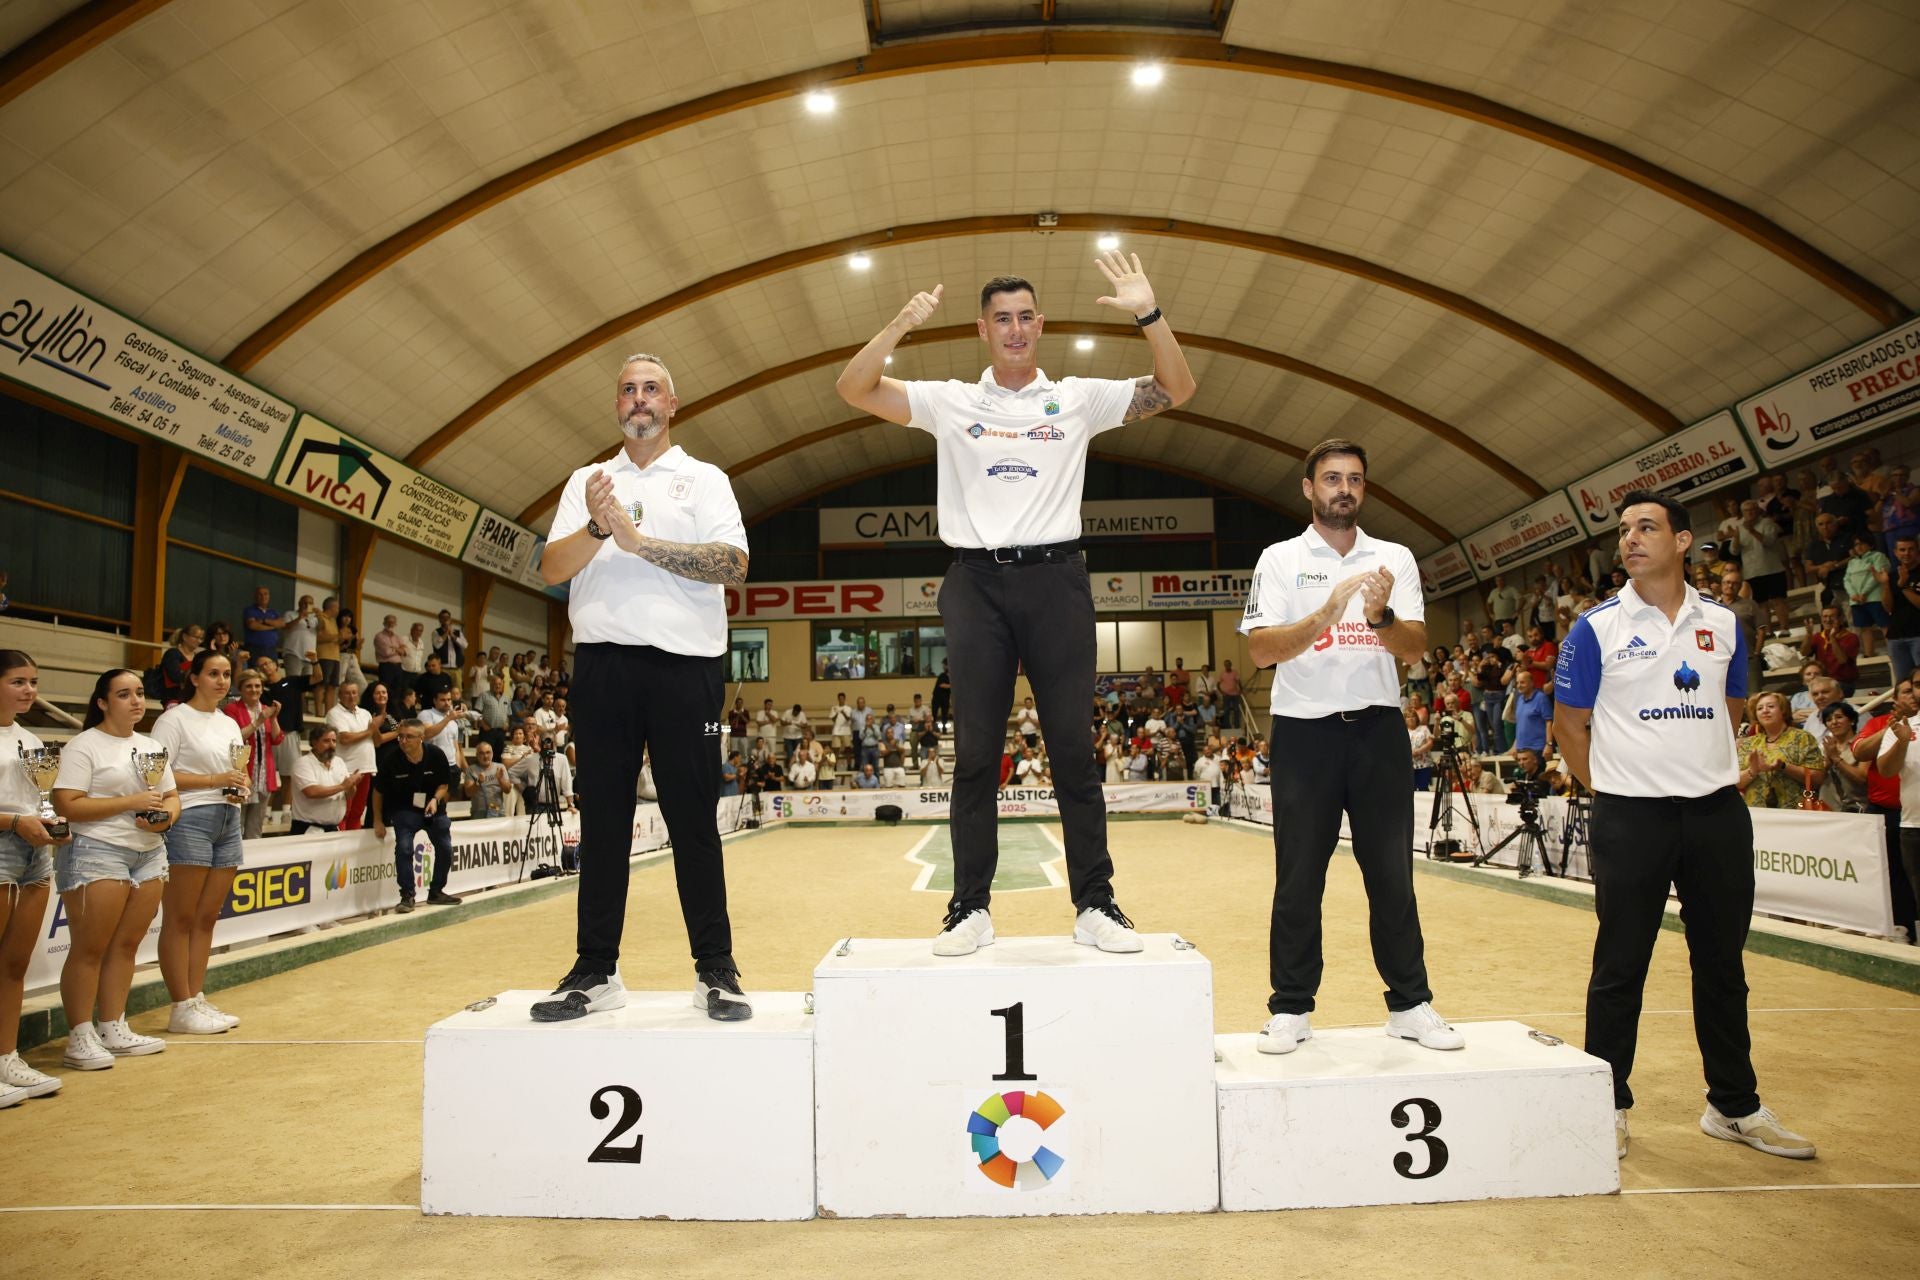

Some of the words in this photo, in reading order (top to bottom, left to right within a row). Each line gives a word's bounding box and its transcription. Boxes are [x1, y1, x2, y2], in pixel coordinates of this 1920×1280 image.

[124, 332, 168, 363] Gestoría
[178, 360, 217, 387] Seguros
[224, 383, 260, 409] Asesoría
[260, 400, 291, 424] Laboral
[1808, 339, 1906, 393] PREFABRICADOS
[114, 350, 150, 375] Fiscal
[146, 368, 156, 382] y
[158, 372, 200, 401] Contable
[209, 397, 230, 415] Auto
[238, 411, 270, 434] Escuela
[129, 385, 177, 414] Astillero
[109, 396, 134, 418] Teléf.
[137, 409, 152, 424] 54
[152, 416, 169, 431] 05
[169, 423, 181, 436] 11
[196, 434, 216, 452] Teléf.
[219, 444, 232, 458] 25
[231, 450, 245, 463] 07
[243, 454, 256, 468] 62
[1636, 442, 1684, 473] DESGUACE
[1708, 440, 1735, 461] S.L.
[305, 468, 367, 515] VICA
[400, 484, 468, 522] CONSTRUCCIONES
[413, 476, 460, 505] CALDERERIA
[457, 499, 466, 507] Y
[409, 502, 451, 528] METALICAS
[482, 518, 520, 552] PARK
[1307, 572, 1328, 582] noja
[1094, 595, 1139, 605] CAMARGO
[1148, 600, 1191, 609] Transporte,
[1193, 598, 1239, 607] distribución
[1617, 652, 1627, 660] La
[1639, 702, 1715, 721] comillas
[1001, 803, 1027, 812] 2025
[1755, 849, 1858, 884] IBERDROLA
[231, 865, 305, 913] SIEC
[990, 1002, 1037, 1081] 1
[588, 1084, 643, 1164] 2
[1390, 1097, 1449, 1179] 3
